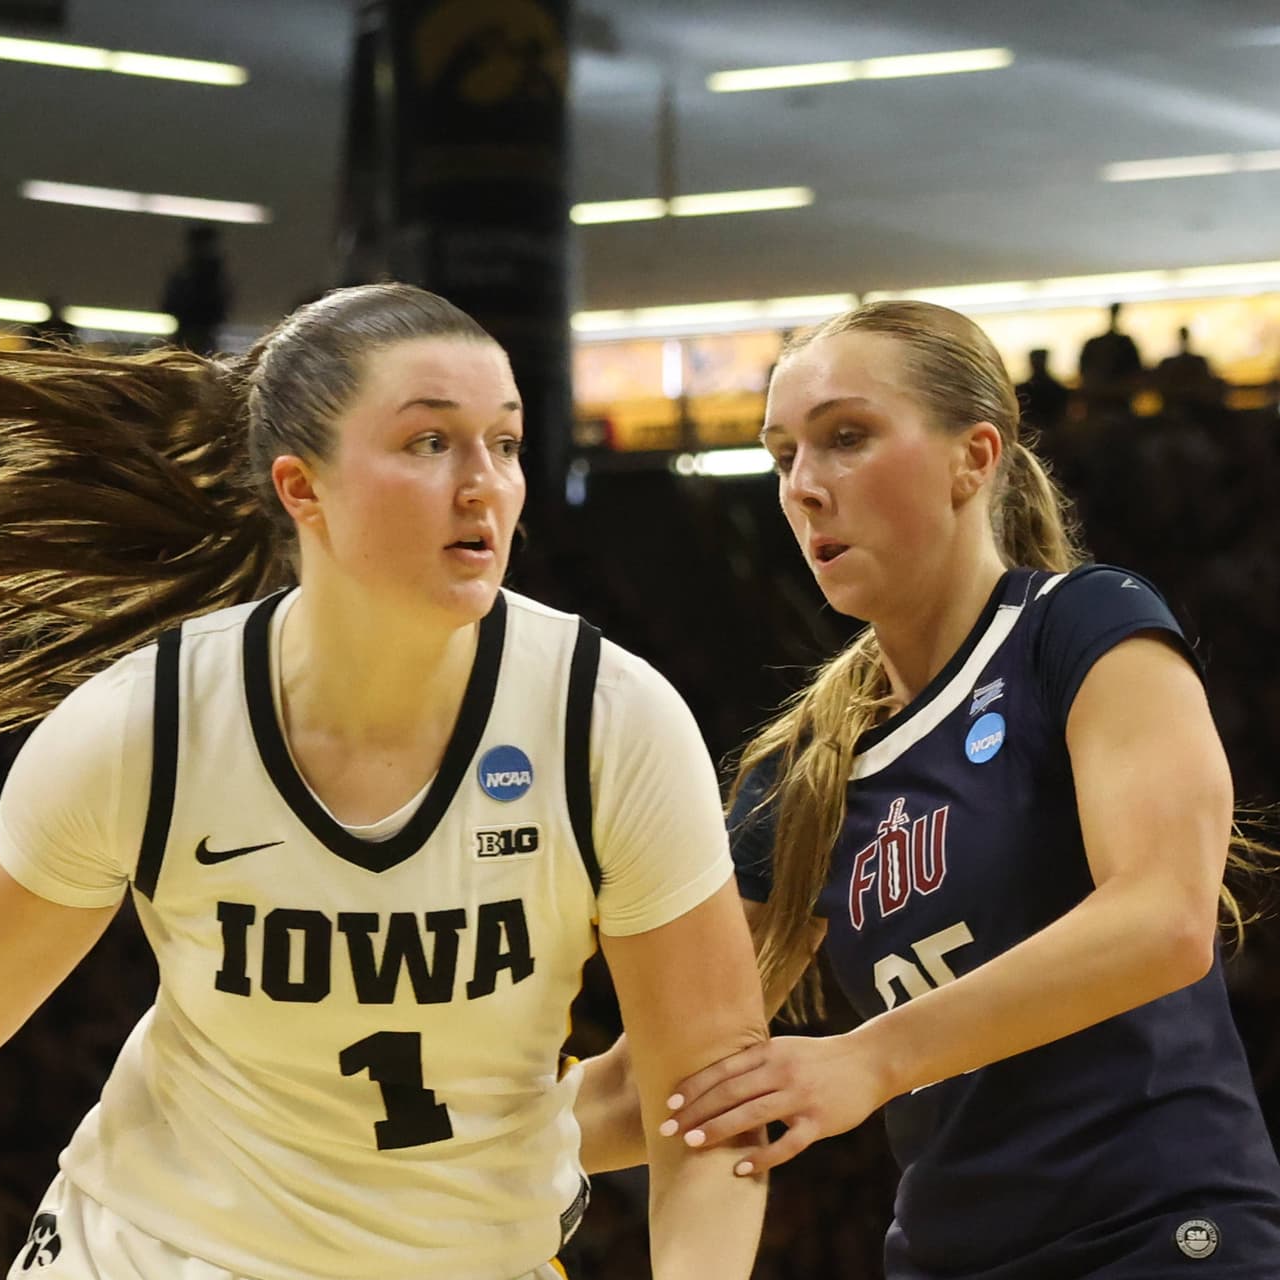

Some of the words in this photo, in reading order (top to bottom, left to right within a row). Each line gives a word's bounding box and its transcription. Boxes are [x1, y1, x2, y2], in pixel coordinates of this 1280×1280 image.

[486, 771, 531, 788] NCAA
[970, 731, 1002, 755] NCAA
[849, 804, 949, 931] FDU
[215, 898, 535, 1005] IOWA
[339, 1031, 454, 1151] 1
